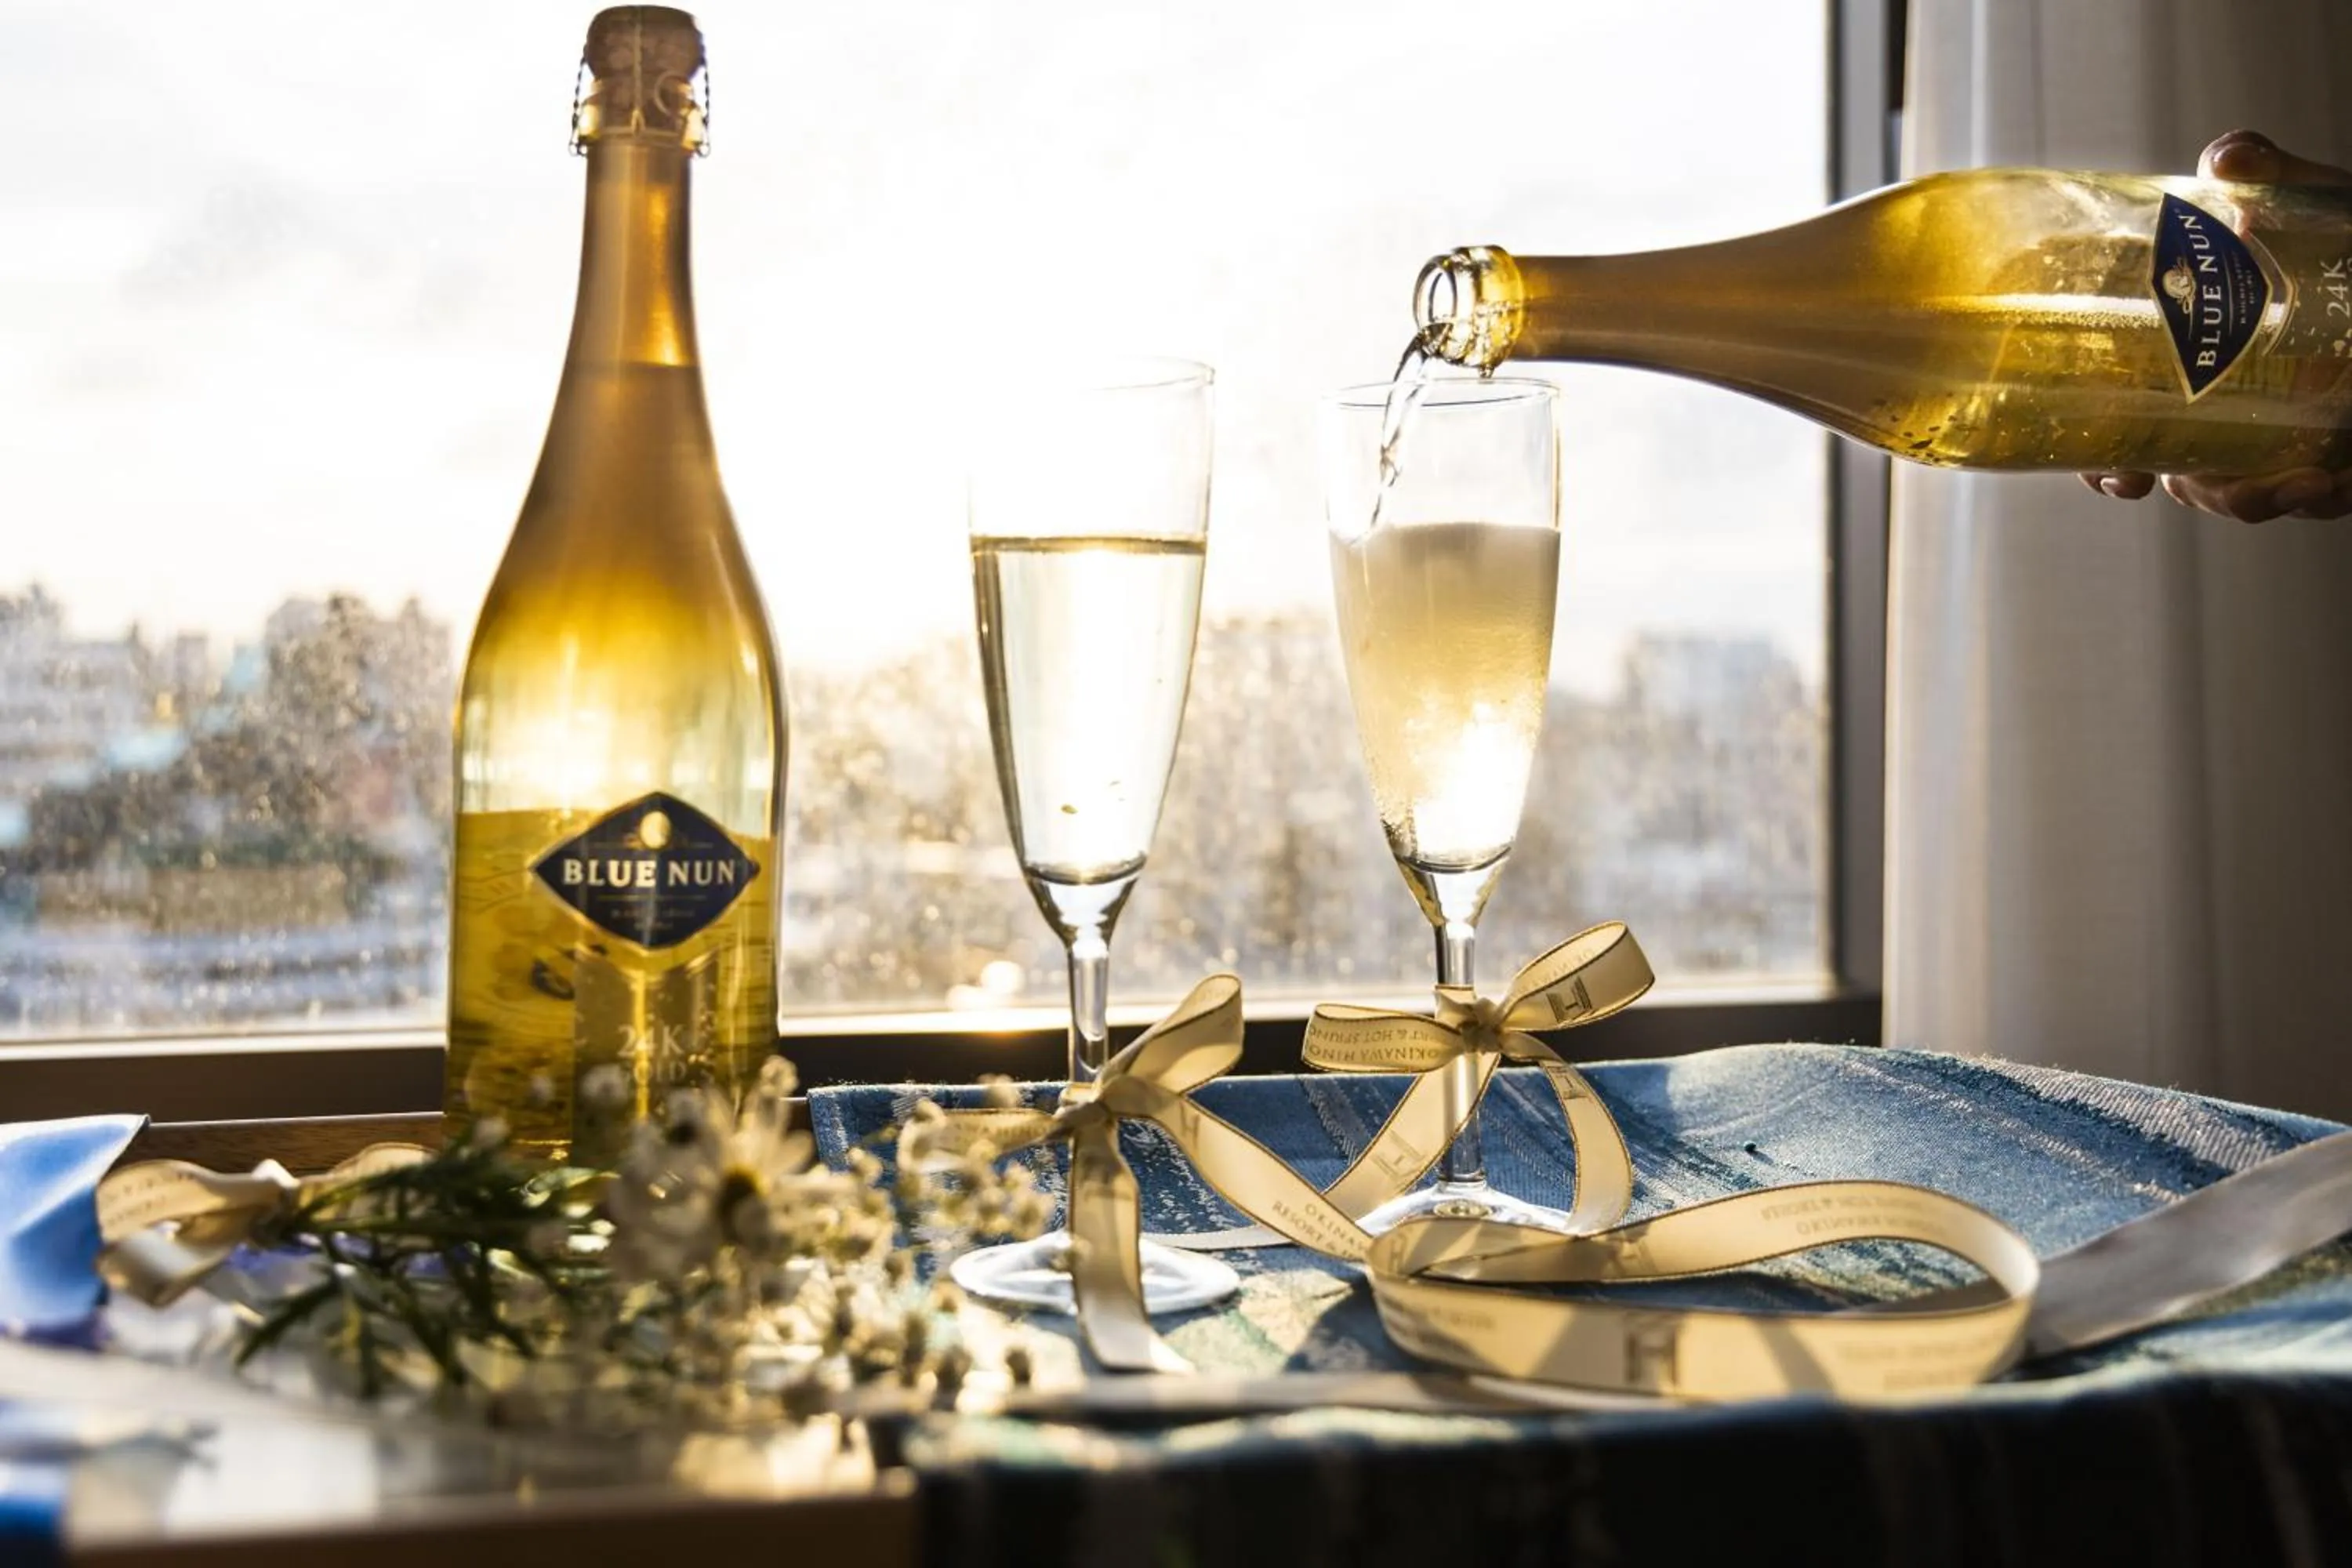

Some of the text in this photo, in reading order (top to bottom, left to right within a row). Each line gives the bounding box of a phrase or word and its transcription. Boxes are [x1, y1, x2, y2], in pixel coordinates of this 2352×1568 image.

[2177, 215, 2223, 368] BLUE NUN
[562, 858, 735, 887] BLUE NUN
[1363, 1029, 1393, 1044] HOT
[1305, 1040, 1439, 1062] OKINAWA HINO
